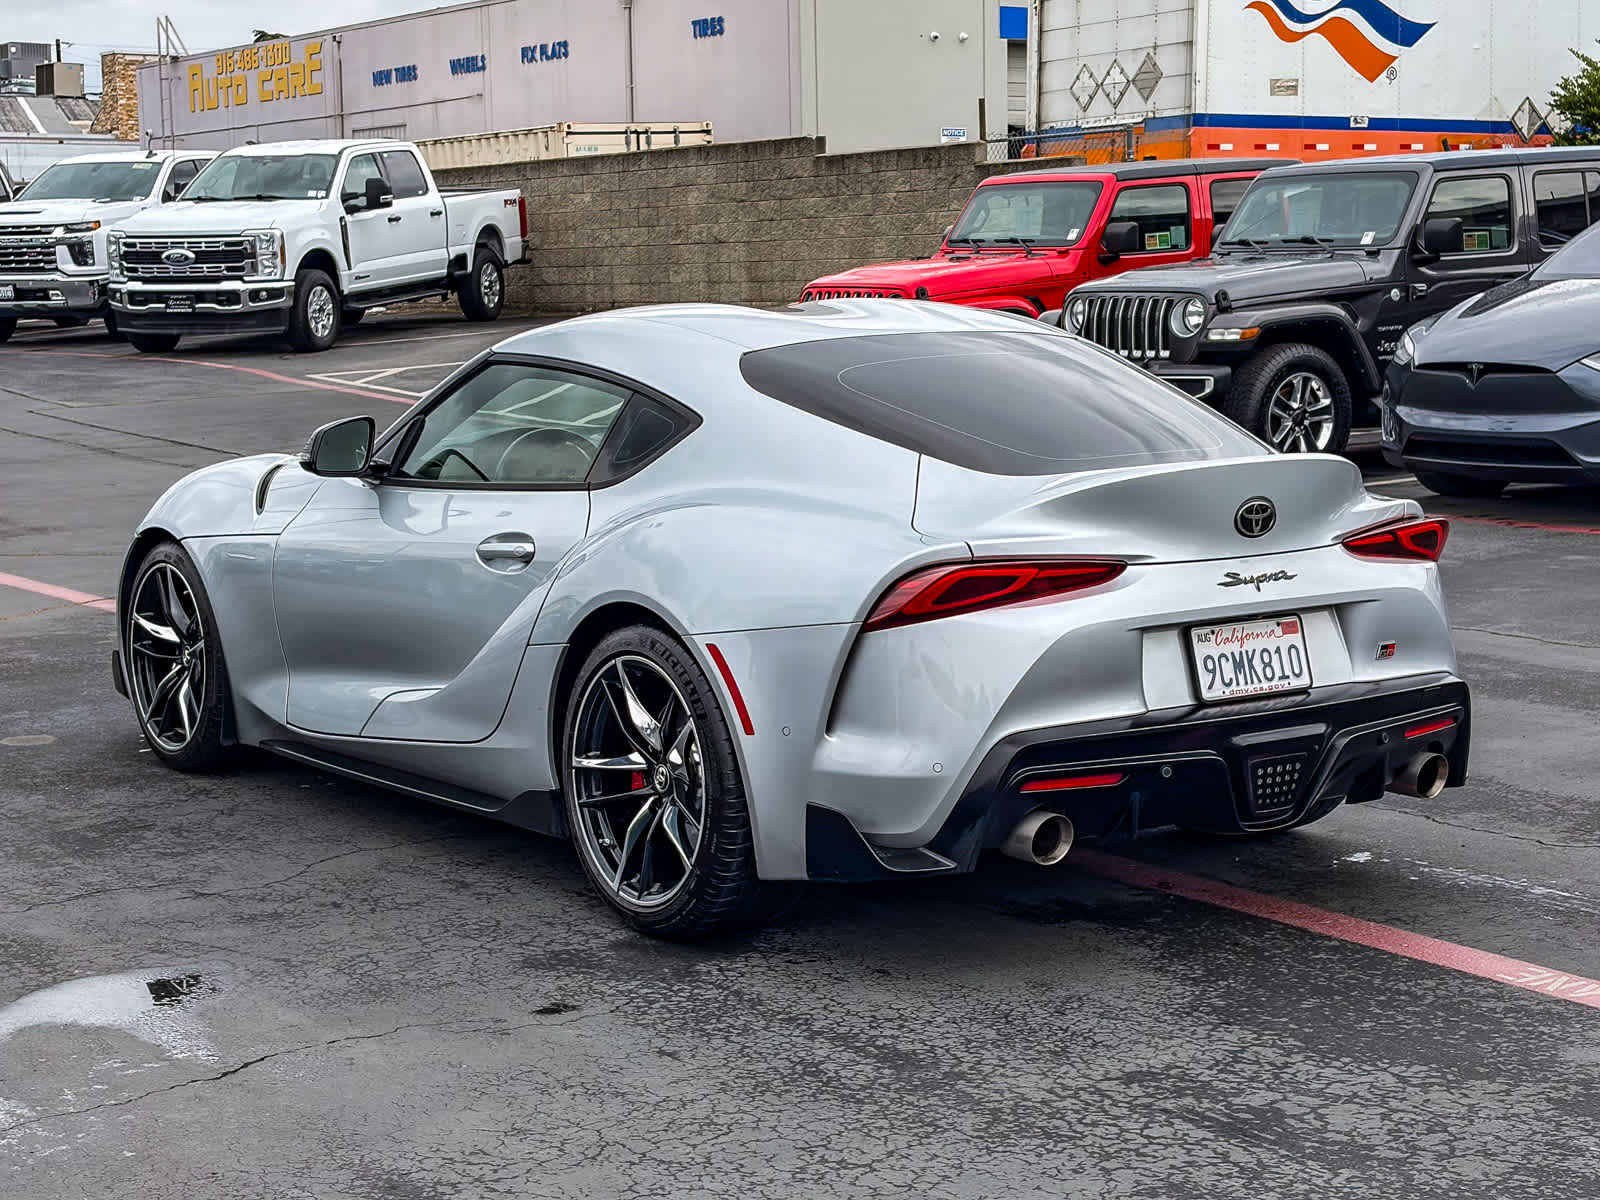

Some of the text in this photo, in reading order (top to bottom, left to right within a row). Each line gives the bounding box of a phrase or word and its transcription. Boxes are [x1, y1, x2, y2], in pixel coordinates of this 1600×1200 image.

[691, 16, 725, 39] TIRES
[521, 40, 569, 64] FIX FLATS
[372, 65, 418, 87] NEW TIRES
[449, 54, 486, 76] WHEELS
[188, 42, 322, 112] AUTO CARE
[1217, 570, 1298, 592] Supra
[1197, 632, 1211, 644] AUG
[1214, 626, 1283, 648] California
[1203, 643, 1303, 690] 9CMK810
